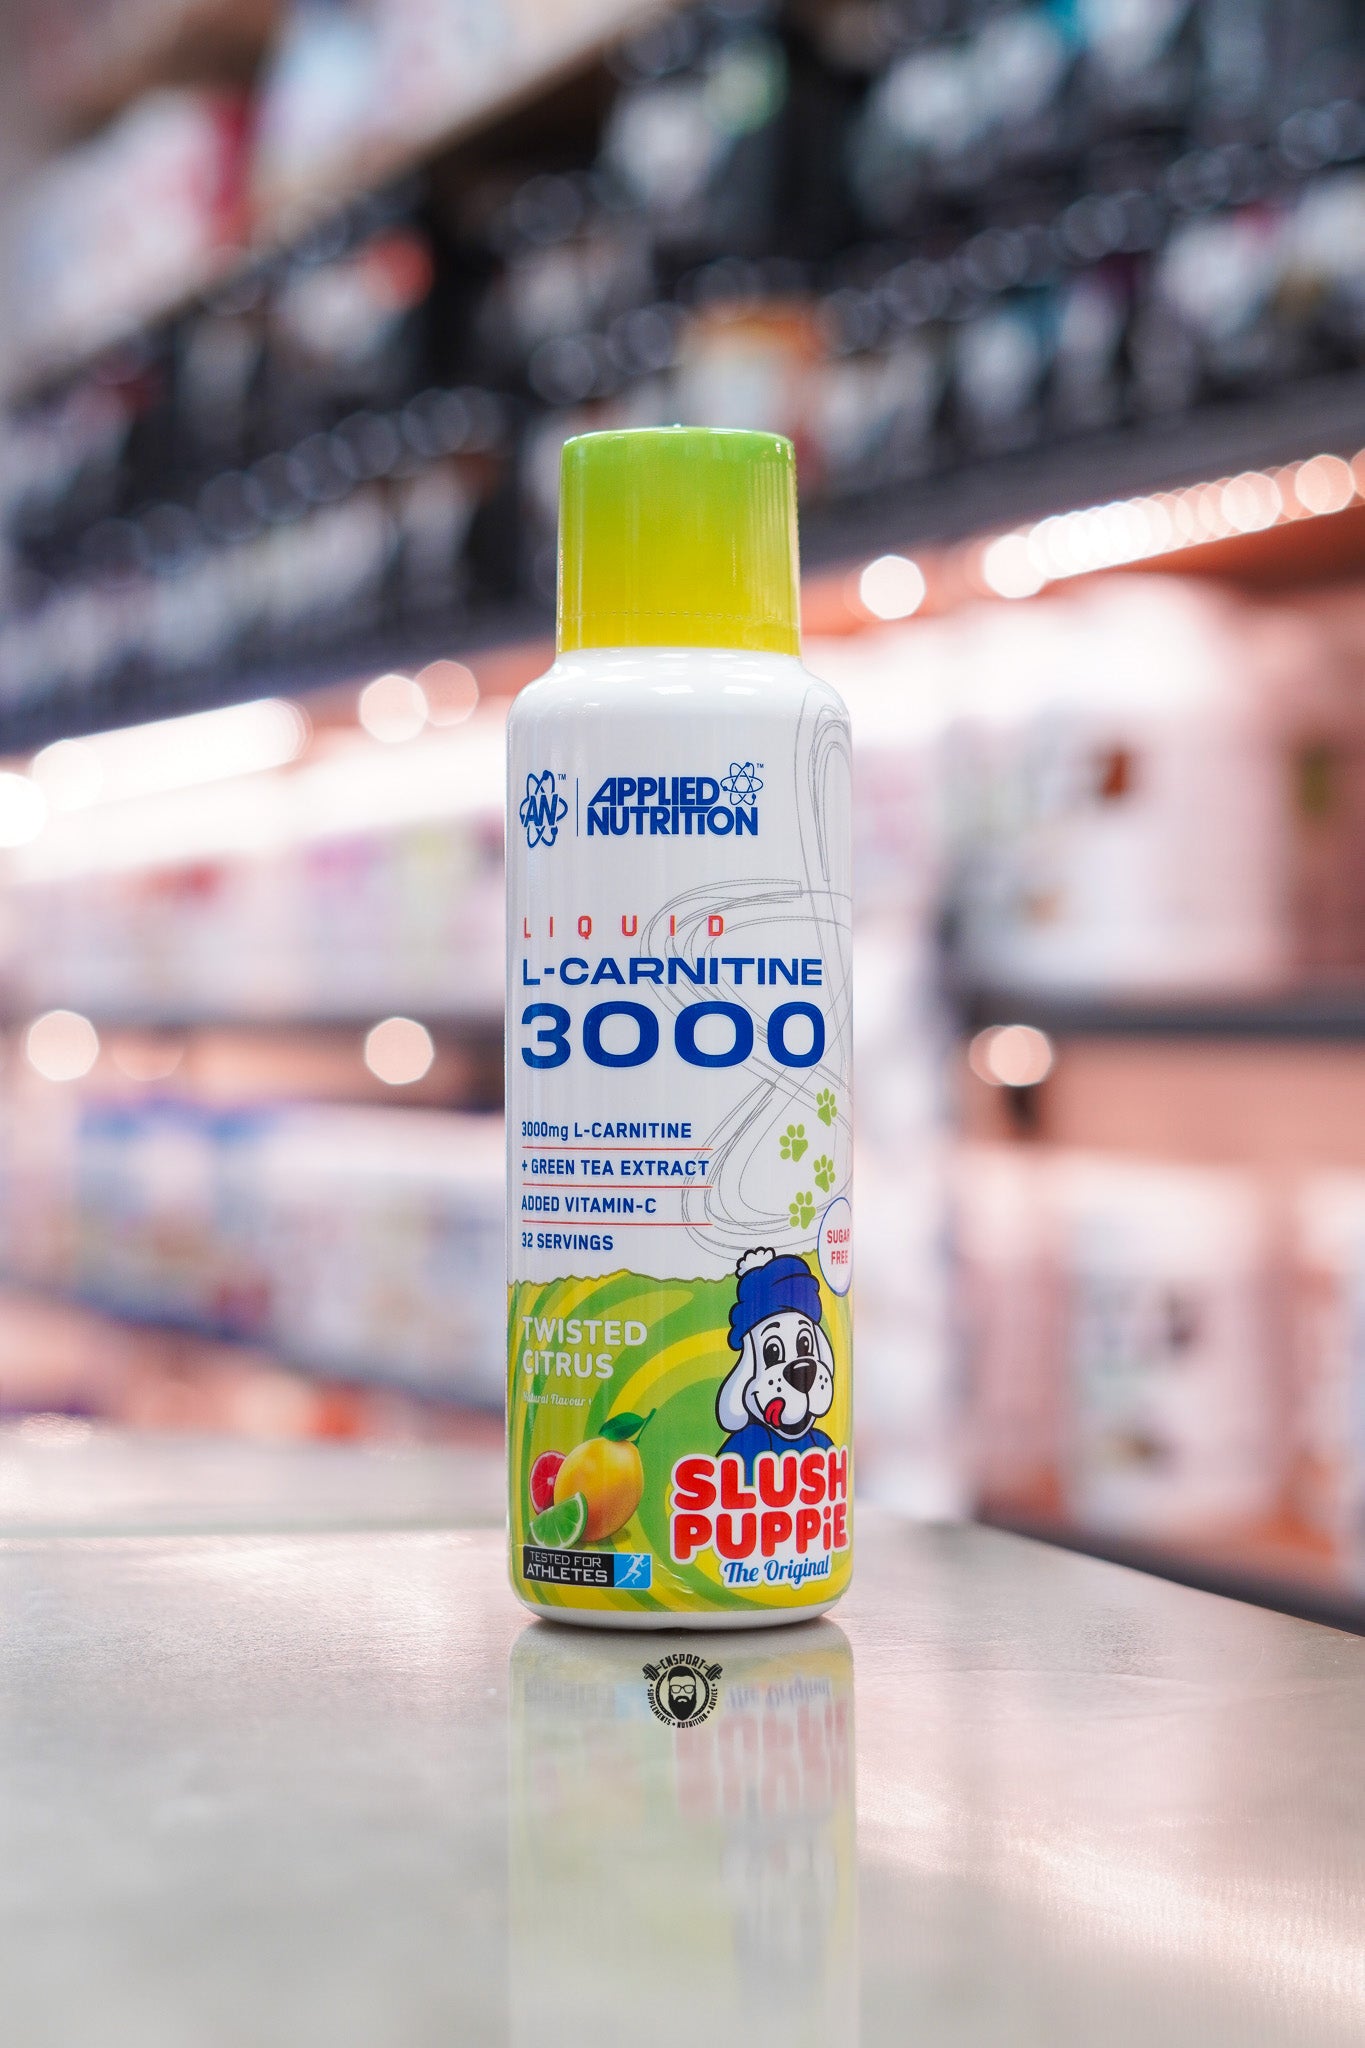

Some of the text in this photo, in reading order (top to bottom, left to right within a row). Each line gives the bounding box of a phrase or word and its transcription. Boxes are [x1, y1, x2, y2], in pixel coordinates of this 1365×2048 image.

[588, 777, 720, 806] APPLIED
[524, 794, 558, 827] AN
[587, 806, 758, 835] NUTRITION
[524, 915, 724, 939] LIQUID
[523, 957, 822, 986] L-CARNITINE
[521, 1001, 825, 1068] 3000
[522, 1121, 691, 1141] 3000mg L-CARNITINE
[532, 1159, 574, 1174] GREEN
[581, 1160, 614, 1175] TEA
[621, 1161, 709, 1175] EXTRACT
[522, 1195, 656, 1213] ADDED VITAMIN-C
[522, 1232, 613, 1250] 32 SERVINGS
[831, 1250, 848, 1265] FREE
[522, 1316, 647, 1346] TWISTED
[522, 1349, 614, 1379] CITRUS
[674, 1450, 846, 1510] SLUSH
[526, 1563, 607, 1582] ATHLETES
[530, 1551, 601, 1568] TESTED FOR
[724, 1555, 829, 1584] The Original
